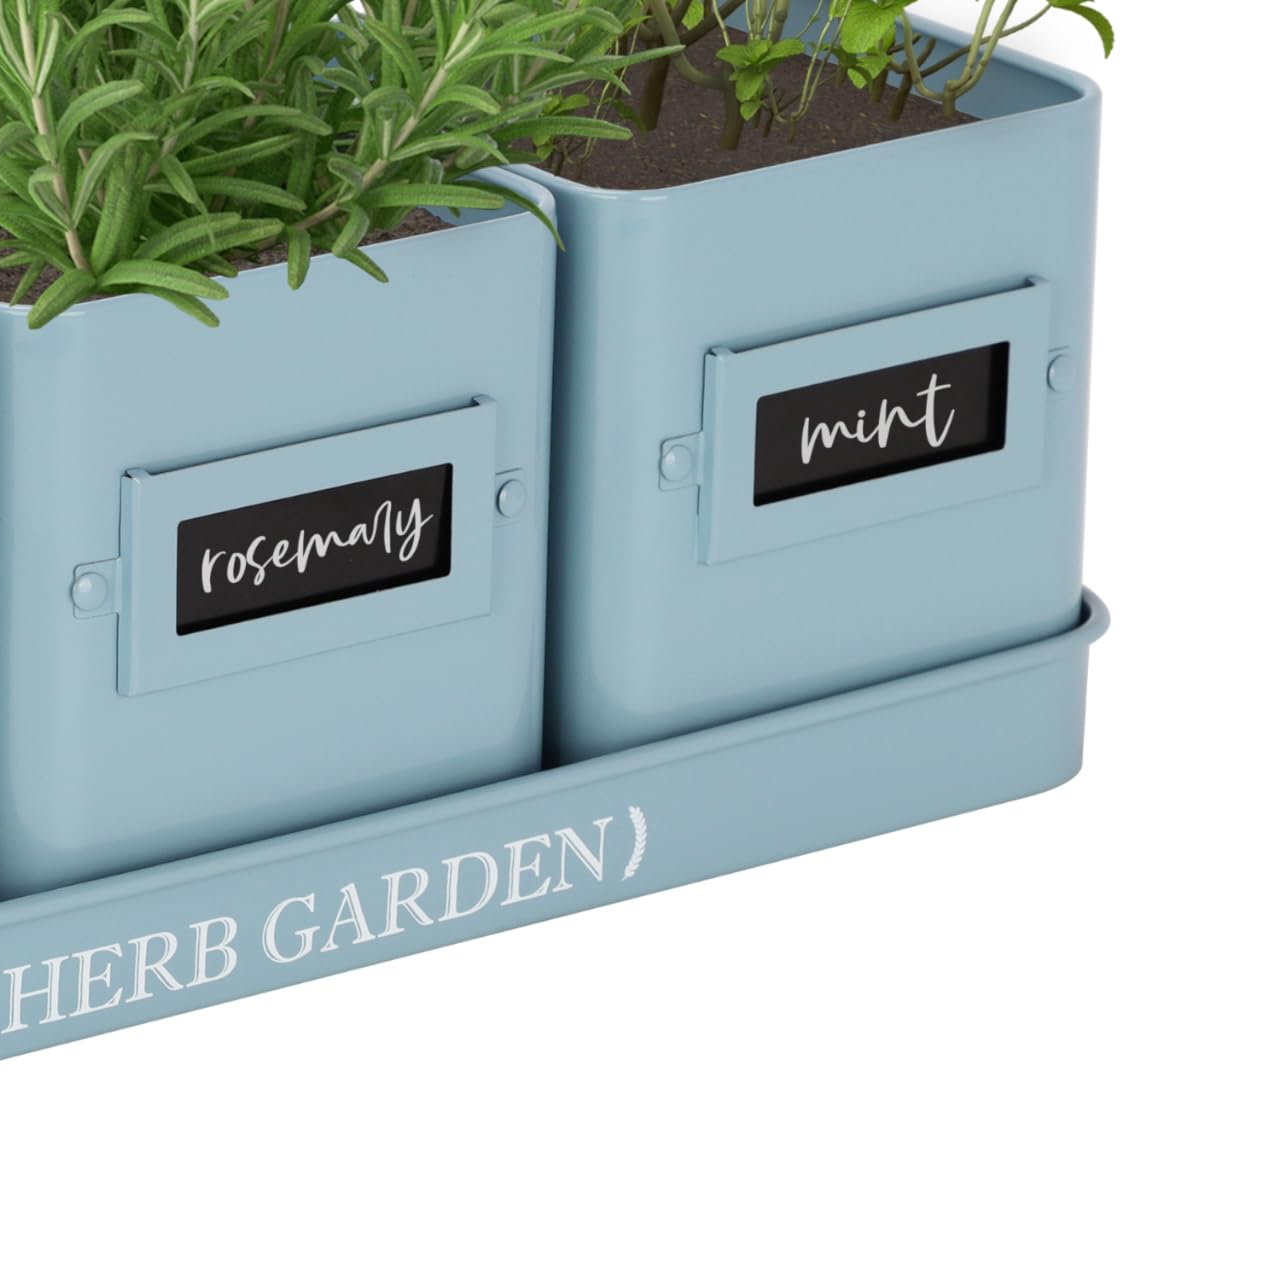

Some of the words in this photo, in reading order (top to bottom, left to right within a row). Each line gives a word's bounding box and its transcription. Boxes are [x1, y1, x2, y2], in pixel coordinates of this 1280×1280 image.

[801, 373, 955, 465] mint
[201, 498, 434, 594] rosemary
[1, 892, 239, 1034] HERB
[262, 816, 613, 963] GARDEN
